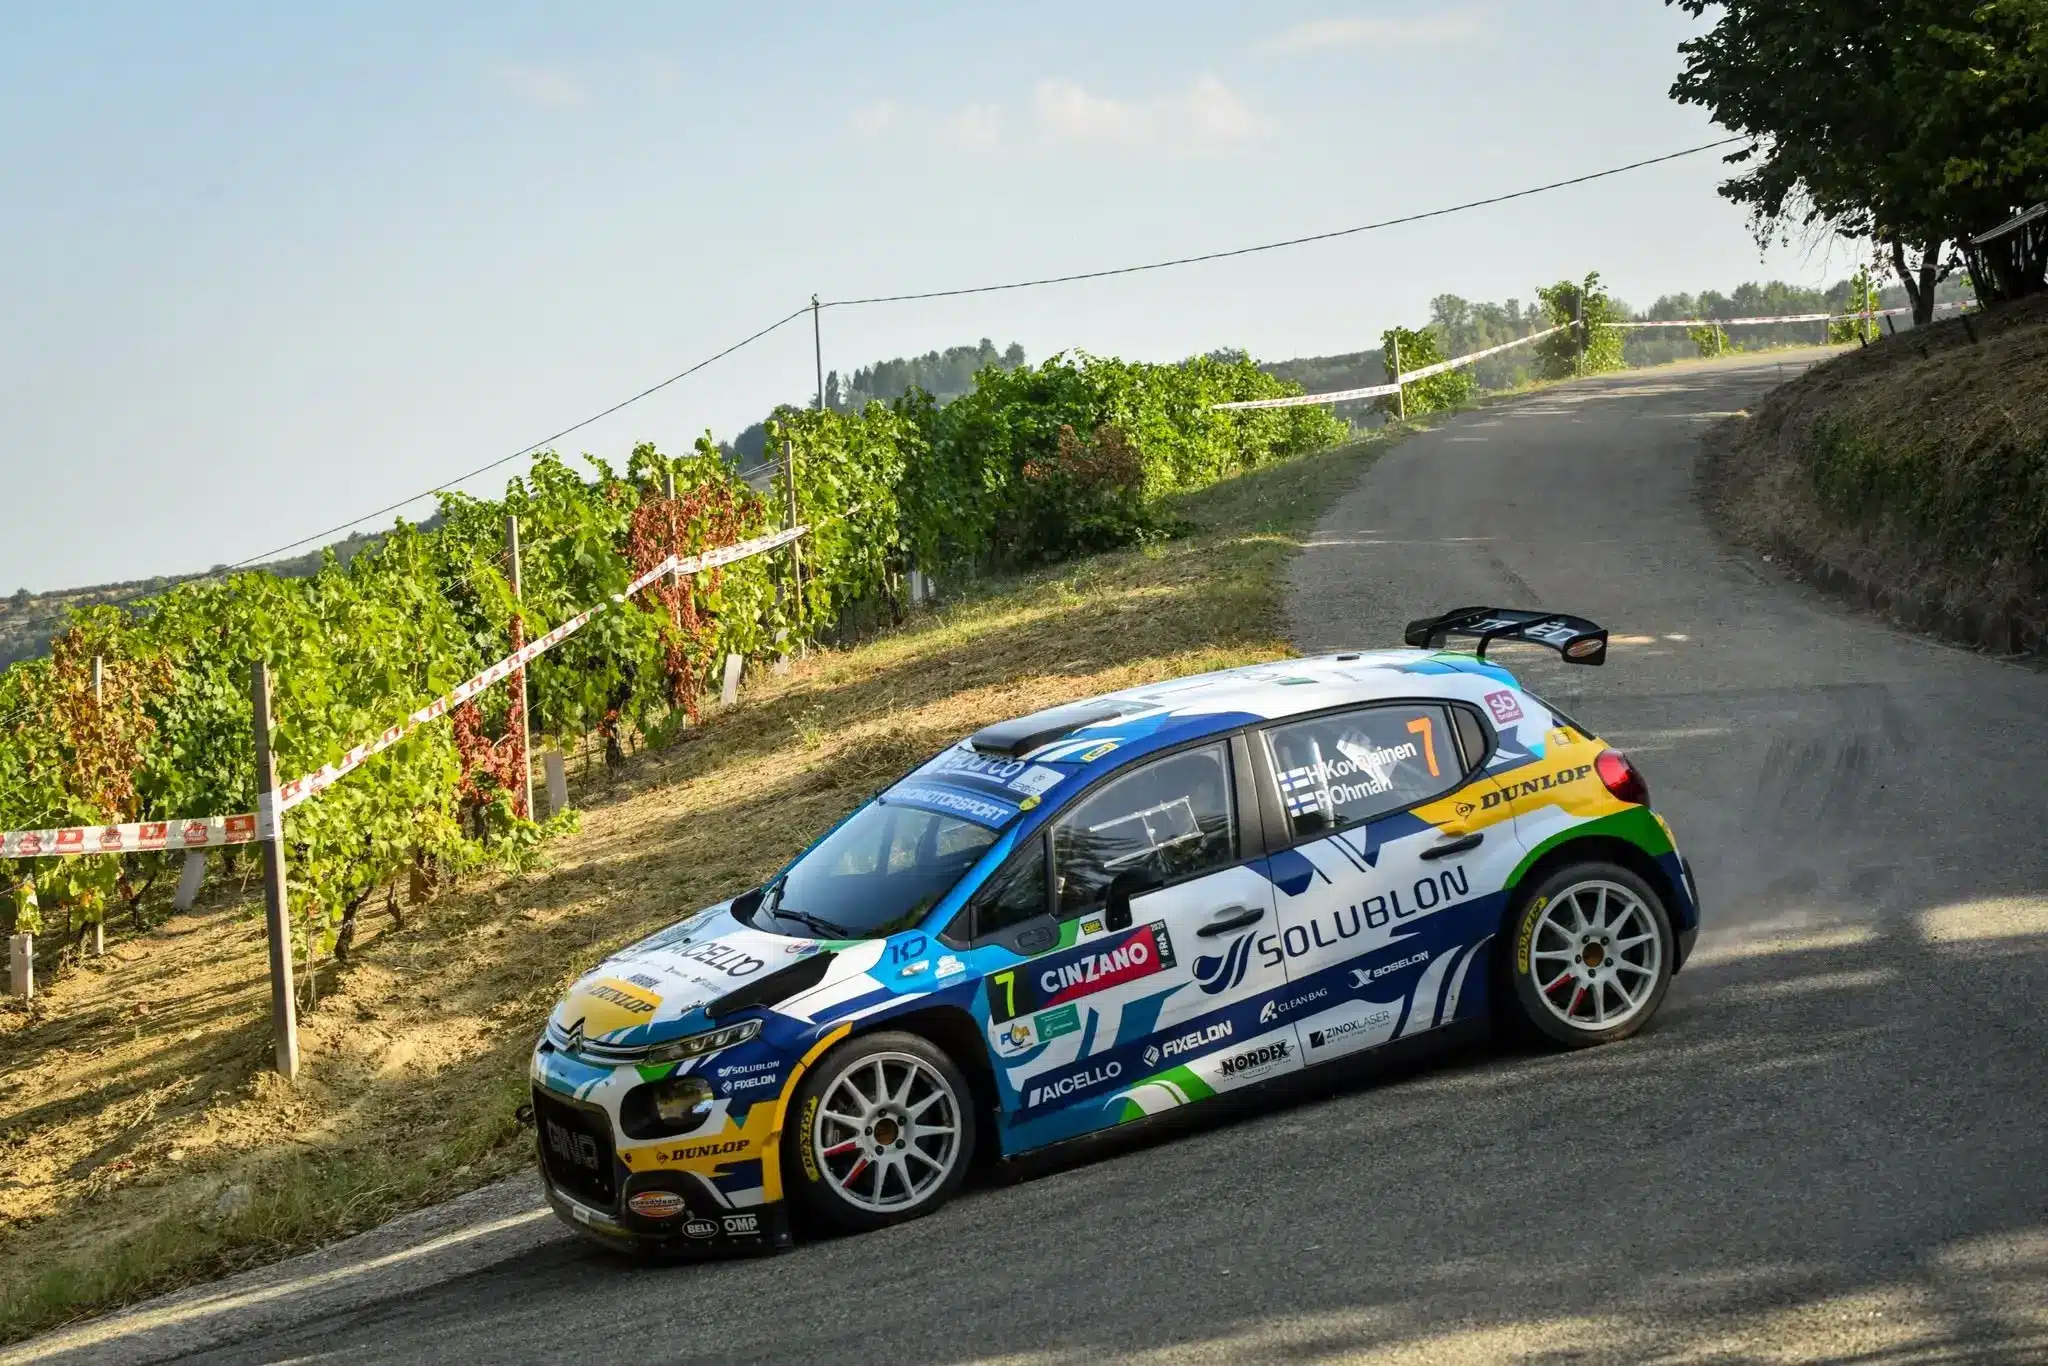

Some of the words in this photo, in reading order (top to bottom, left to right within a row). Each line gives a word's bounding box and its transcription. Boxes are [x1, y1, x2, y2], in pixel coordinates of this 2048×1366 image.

[1407, 716, 1441, 777] 7
[1480, 764, 1593, 810] DUNLOP
[1257, 865, 1469, 968] SOLUBLON
[1040, 942, 1149, 993] CINZANO
[1373, 950, 1430, 980] BOSELON
[994, 970, 1015, 1018] 7
[1277, 994, 1306, 1014] CLEAN
[1307, 987, 1328, 1004] BAG
[1161, 1020, 1233, 1060] FIXELON
[1325, 1010, 1391, 1039] ZINOXLASER
[732, 1060, 780, 1075] SOLUBLON
[1220, 1039, 1290, 1078] NORDEX
[733, 1074, 776, 1090] FIXELON
[1040, 1060, 1123, 1105] AICELLO
[671, 1139, 750, 1161] DUNLOP
[686, 1223, 715, 1234] BELL
[723, 1217, 758, 1232] OMP
